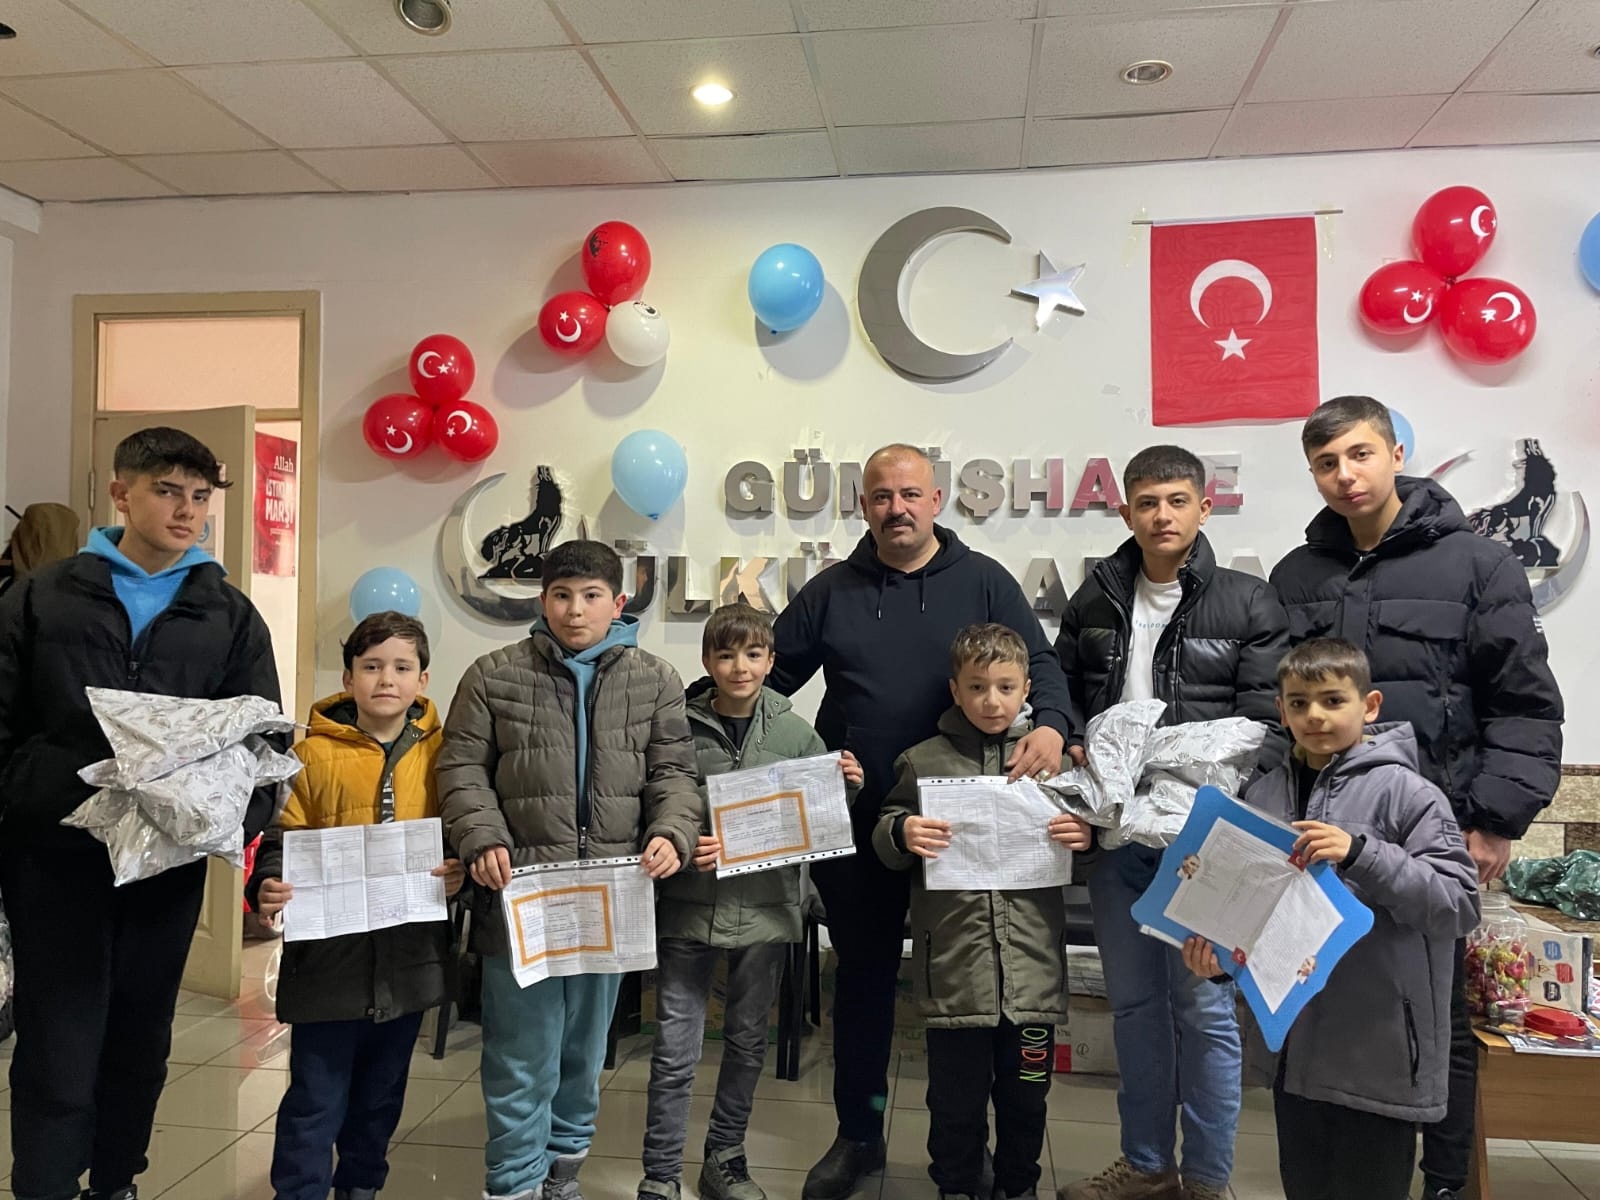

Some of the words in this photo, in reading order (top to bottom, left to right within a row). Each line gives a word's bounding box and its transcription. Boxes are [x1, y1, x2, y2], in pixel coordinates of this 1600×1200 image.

[273, 455, 294, 472] Allah
[724, 447, 1244, 518] GÜŞHAE
[1019, 1027, 1049, 1082] ONDON
